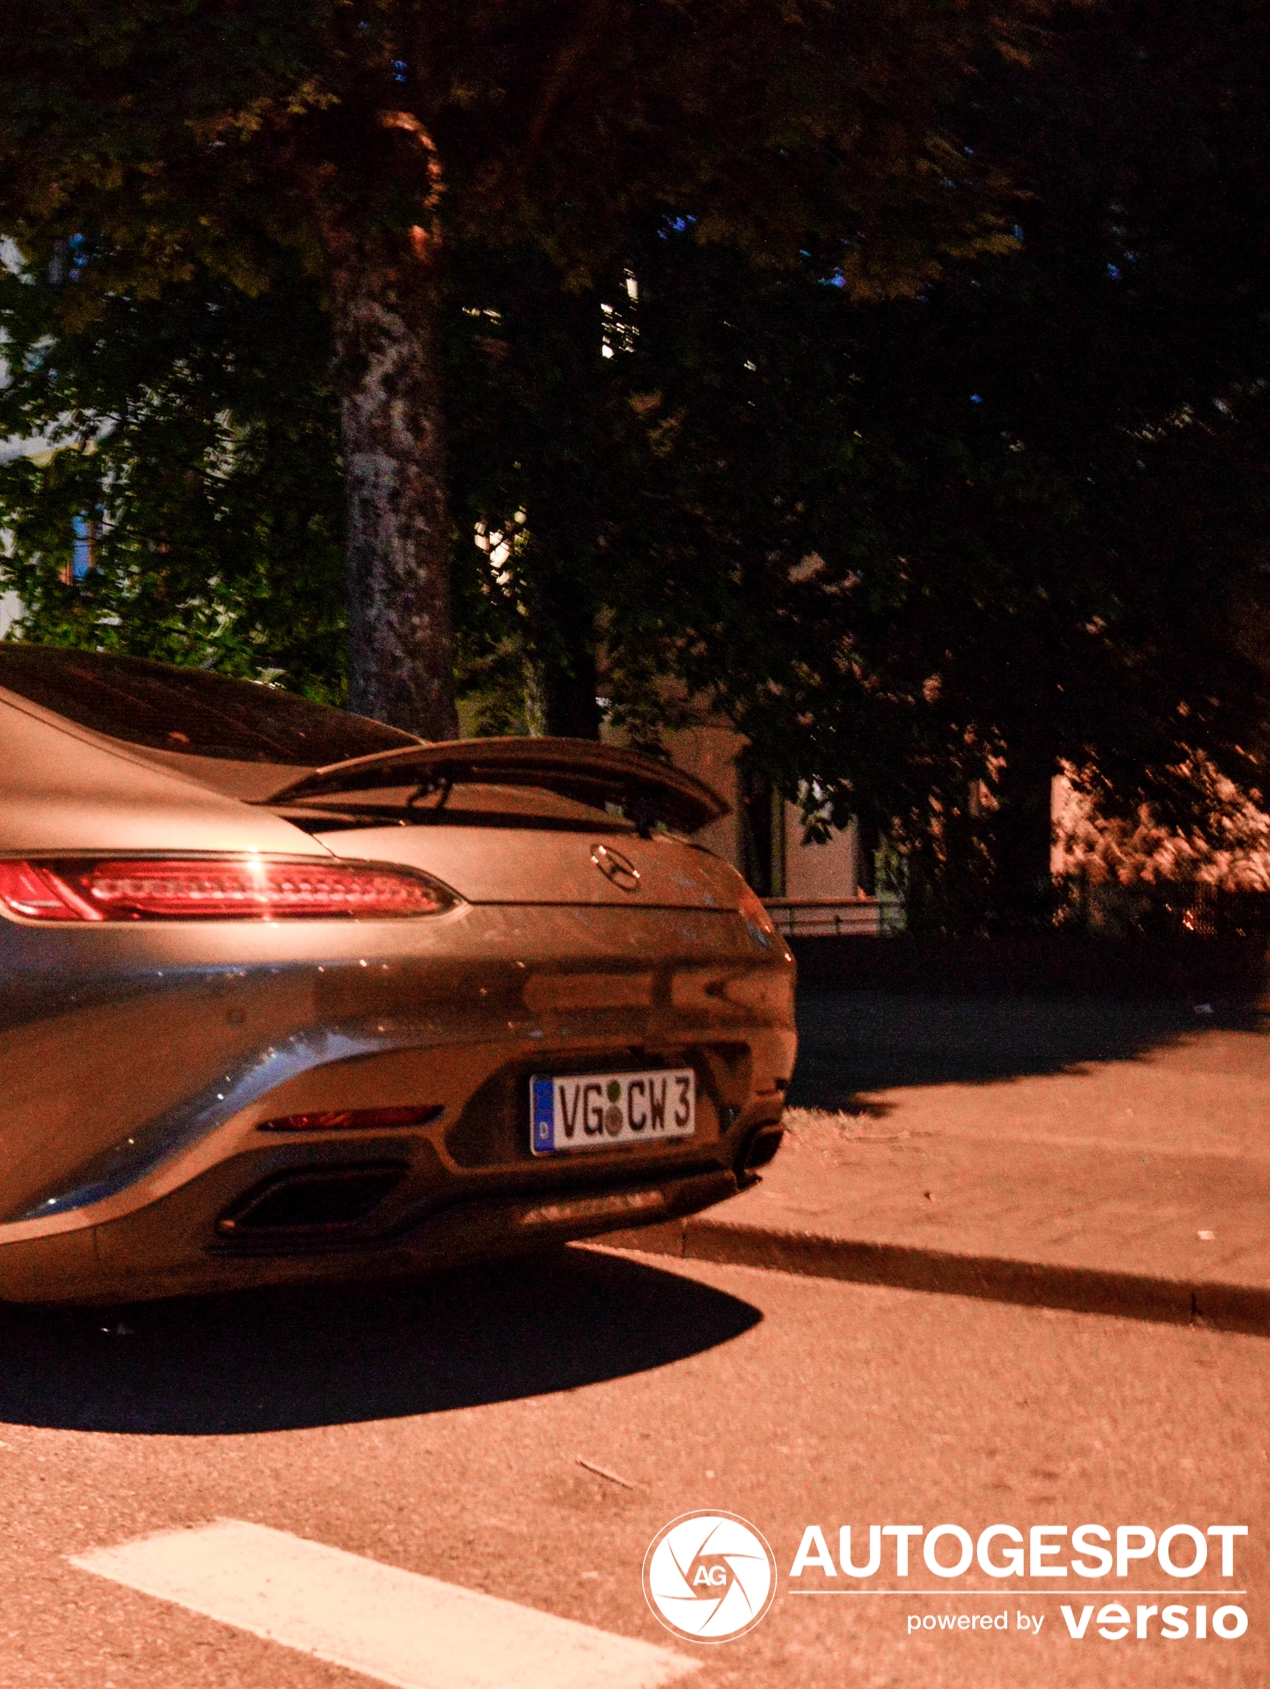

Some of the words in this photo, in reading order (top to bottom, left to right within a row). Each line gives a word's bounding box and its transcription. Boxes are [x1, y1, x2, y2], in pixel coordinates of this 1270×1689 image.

[559, 1083, 604, 1140] VG
[627, 1077, 668, 1132] CW
[673, 1075, 690, 1128] 3
[538, 1121, 549, 1140] D
